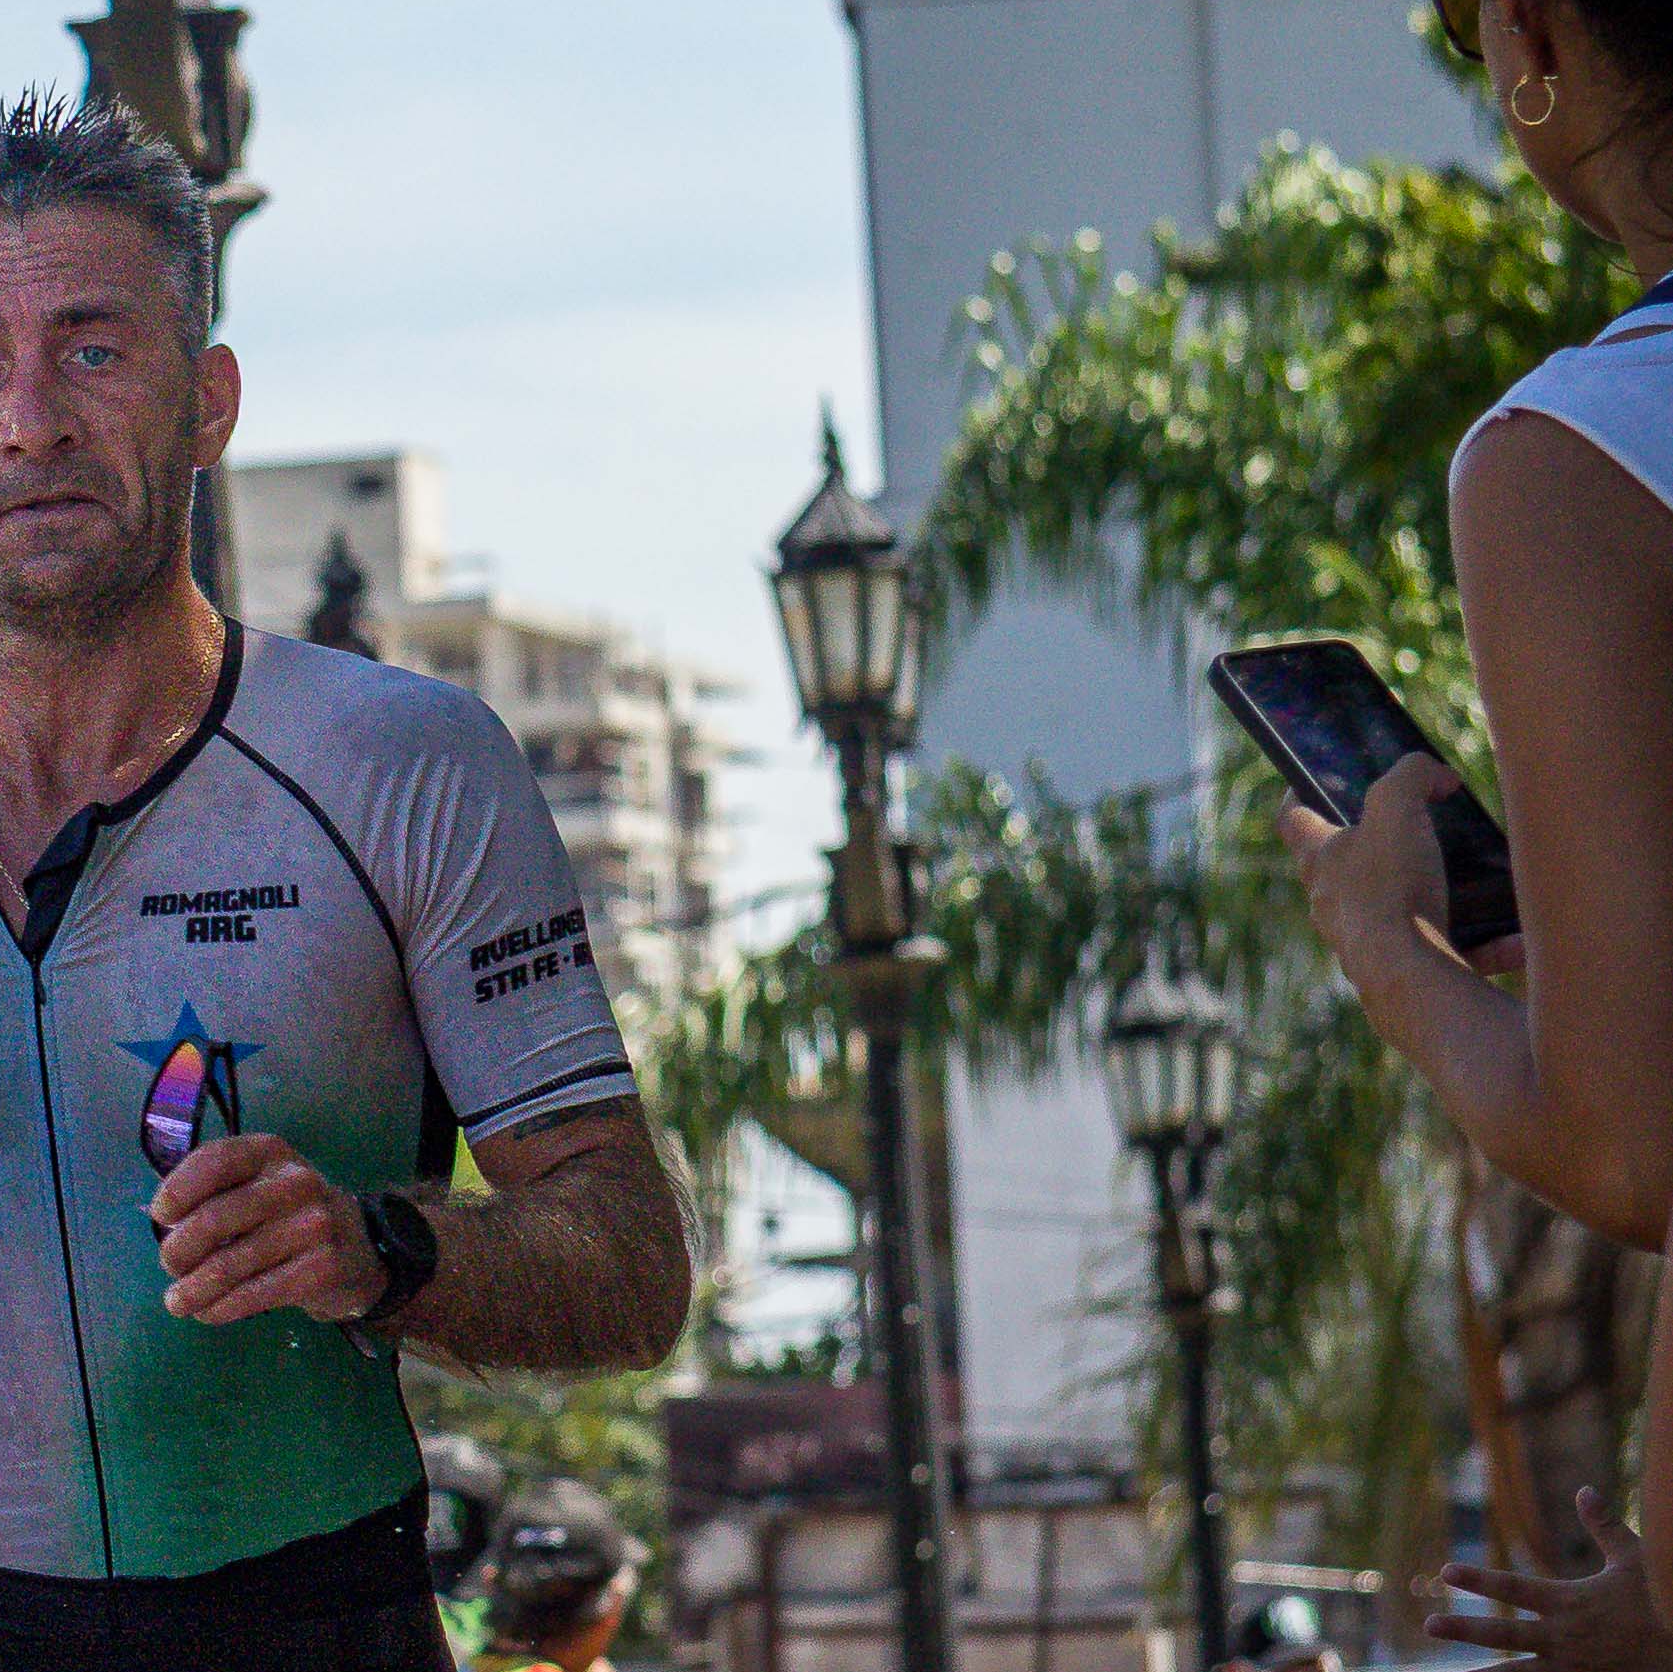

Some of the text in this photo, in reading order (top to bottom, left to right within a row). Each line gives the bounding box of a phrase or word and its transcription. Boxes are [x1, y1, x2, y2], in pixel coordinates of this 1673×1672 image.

[140, 884, 300, 917] ROMAGNOLI
[185, 914, 258, 943] ARG
[532, 951, 560, 982] FE
